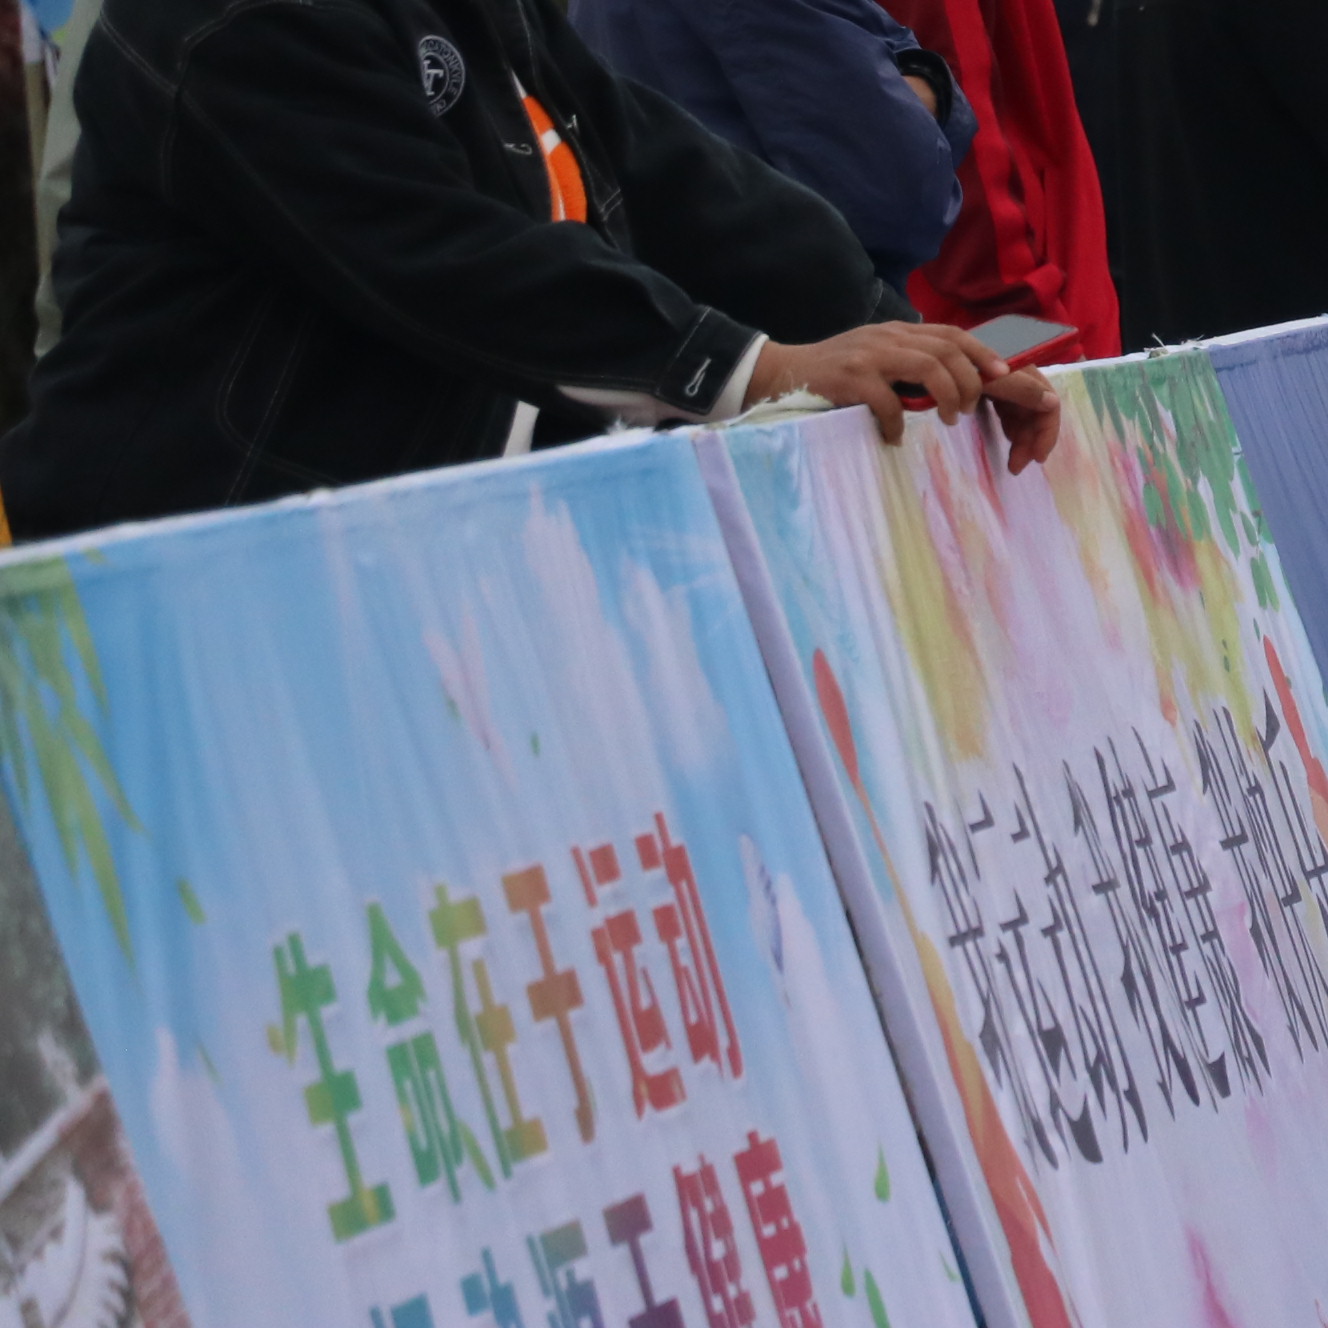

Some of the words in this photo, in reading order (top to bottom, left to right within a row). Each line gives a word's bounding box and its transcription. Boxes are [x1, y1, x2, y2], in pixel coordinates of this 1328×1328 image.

[267, 812, 744, 1242] 生命在于运动
